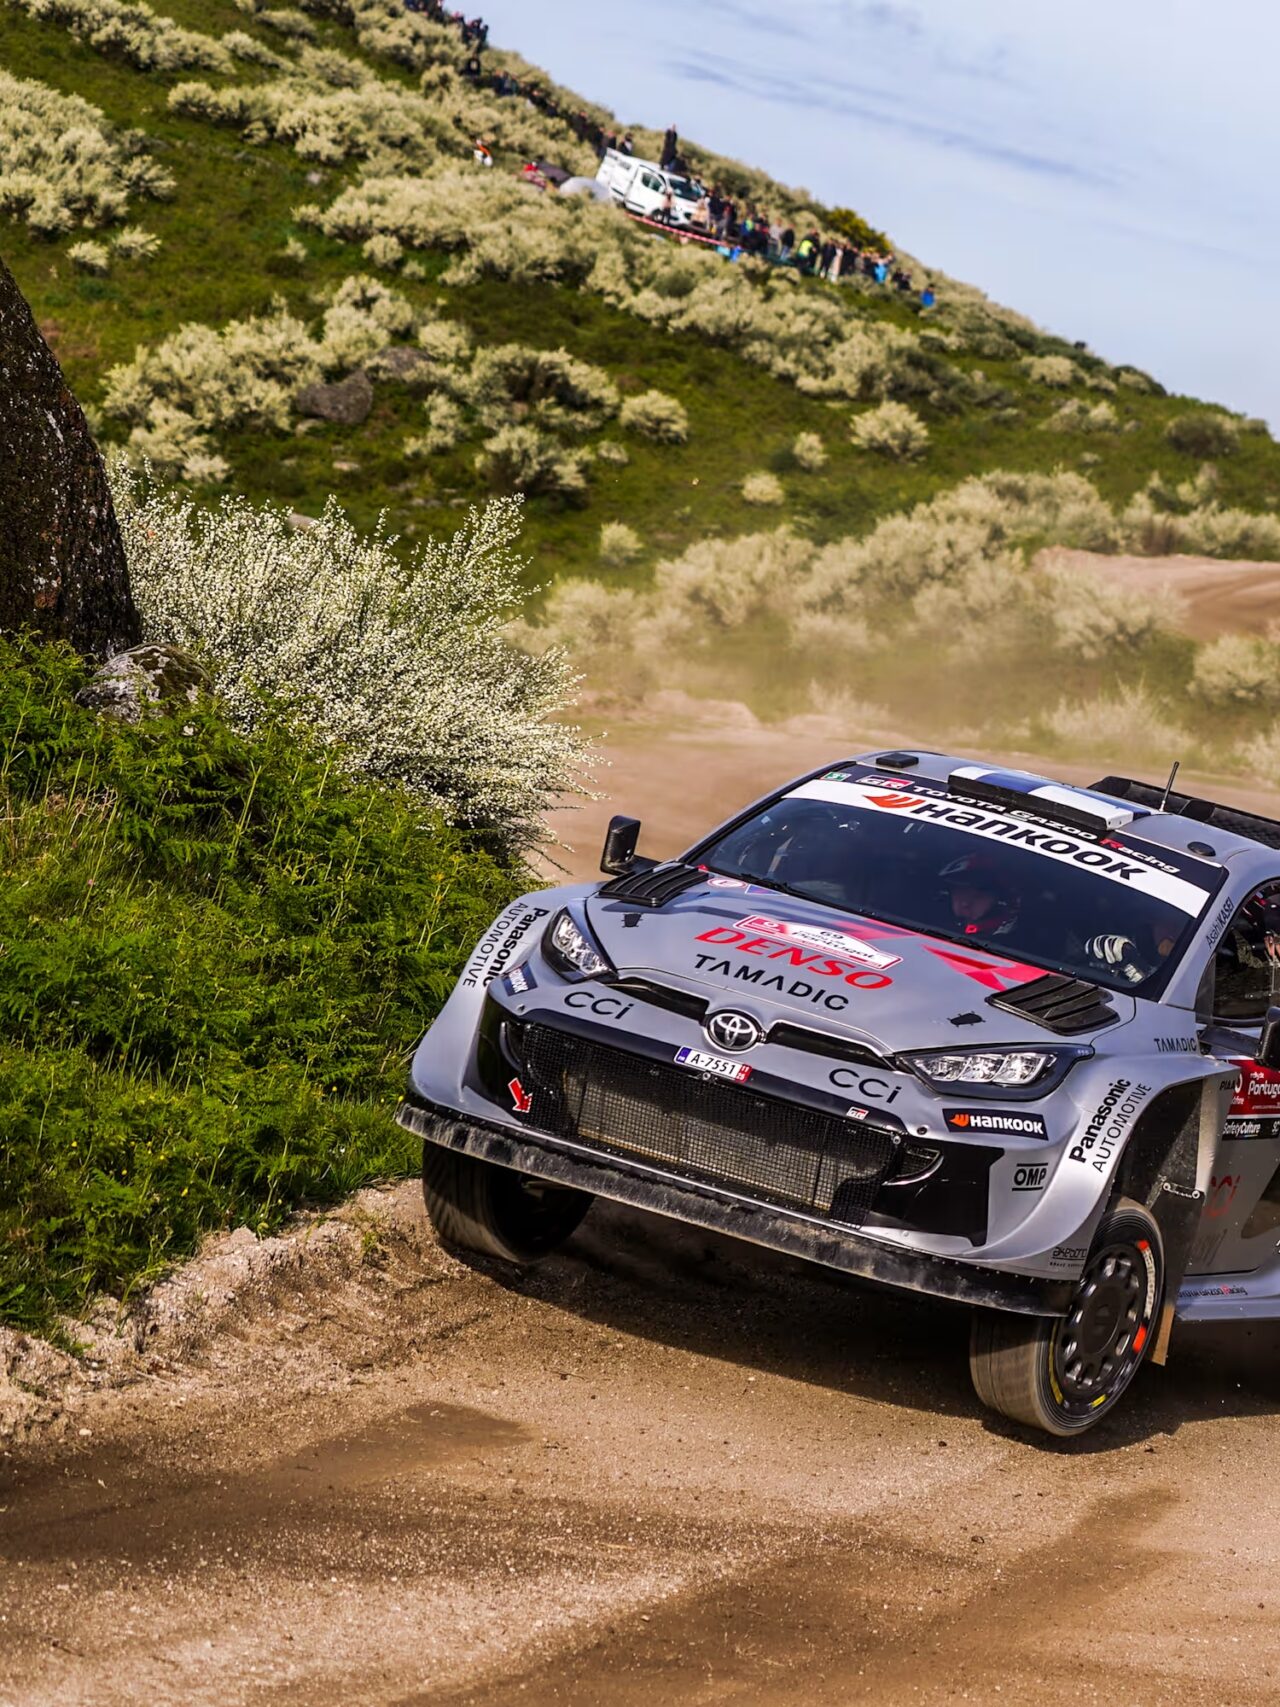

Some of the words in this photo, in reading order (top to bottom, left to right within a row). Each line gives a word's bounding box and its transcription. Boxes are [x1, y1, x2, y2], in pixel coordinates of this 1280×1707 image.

[913, 785, 1006, 814] TOYOTA
[1009, 809, 1098, 840] GAZOO
[1100, 838, 1181, 873] Racing
[462, 902, 529, 988] AUTOMOTIVE
[483, 907, 550, 987] Panasonic
[694, 926, 894, 990] DENSO
[693, 953, 849, 1011] TAMADIC
[690, 1053, 737, 1075] A-7551
[1154, 1037, 1197, 1053] TAMADIC
[1068, 1078, 1132, 1164] Panasonic
[1092, 1083, 1153, 1173] AUTOMOTIVE
[1013, 1167, 1047, 1187] OMP
